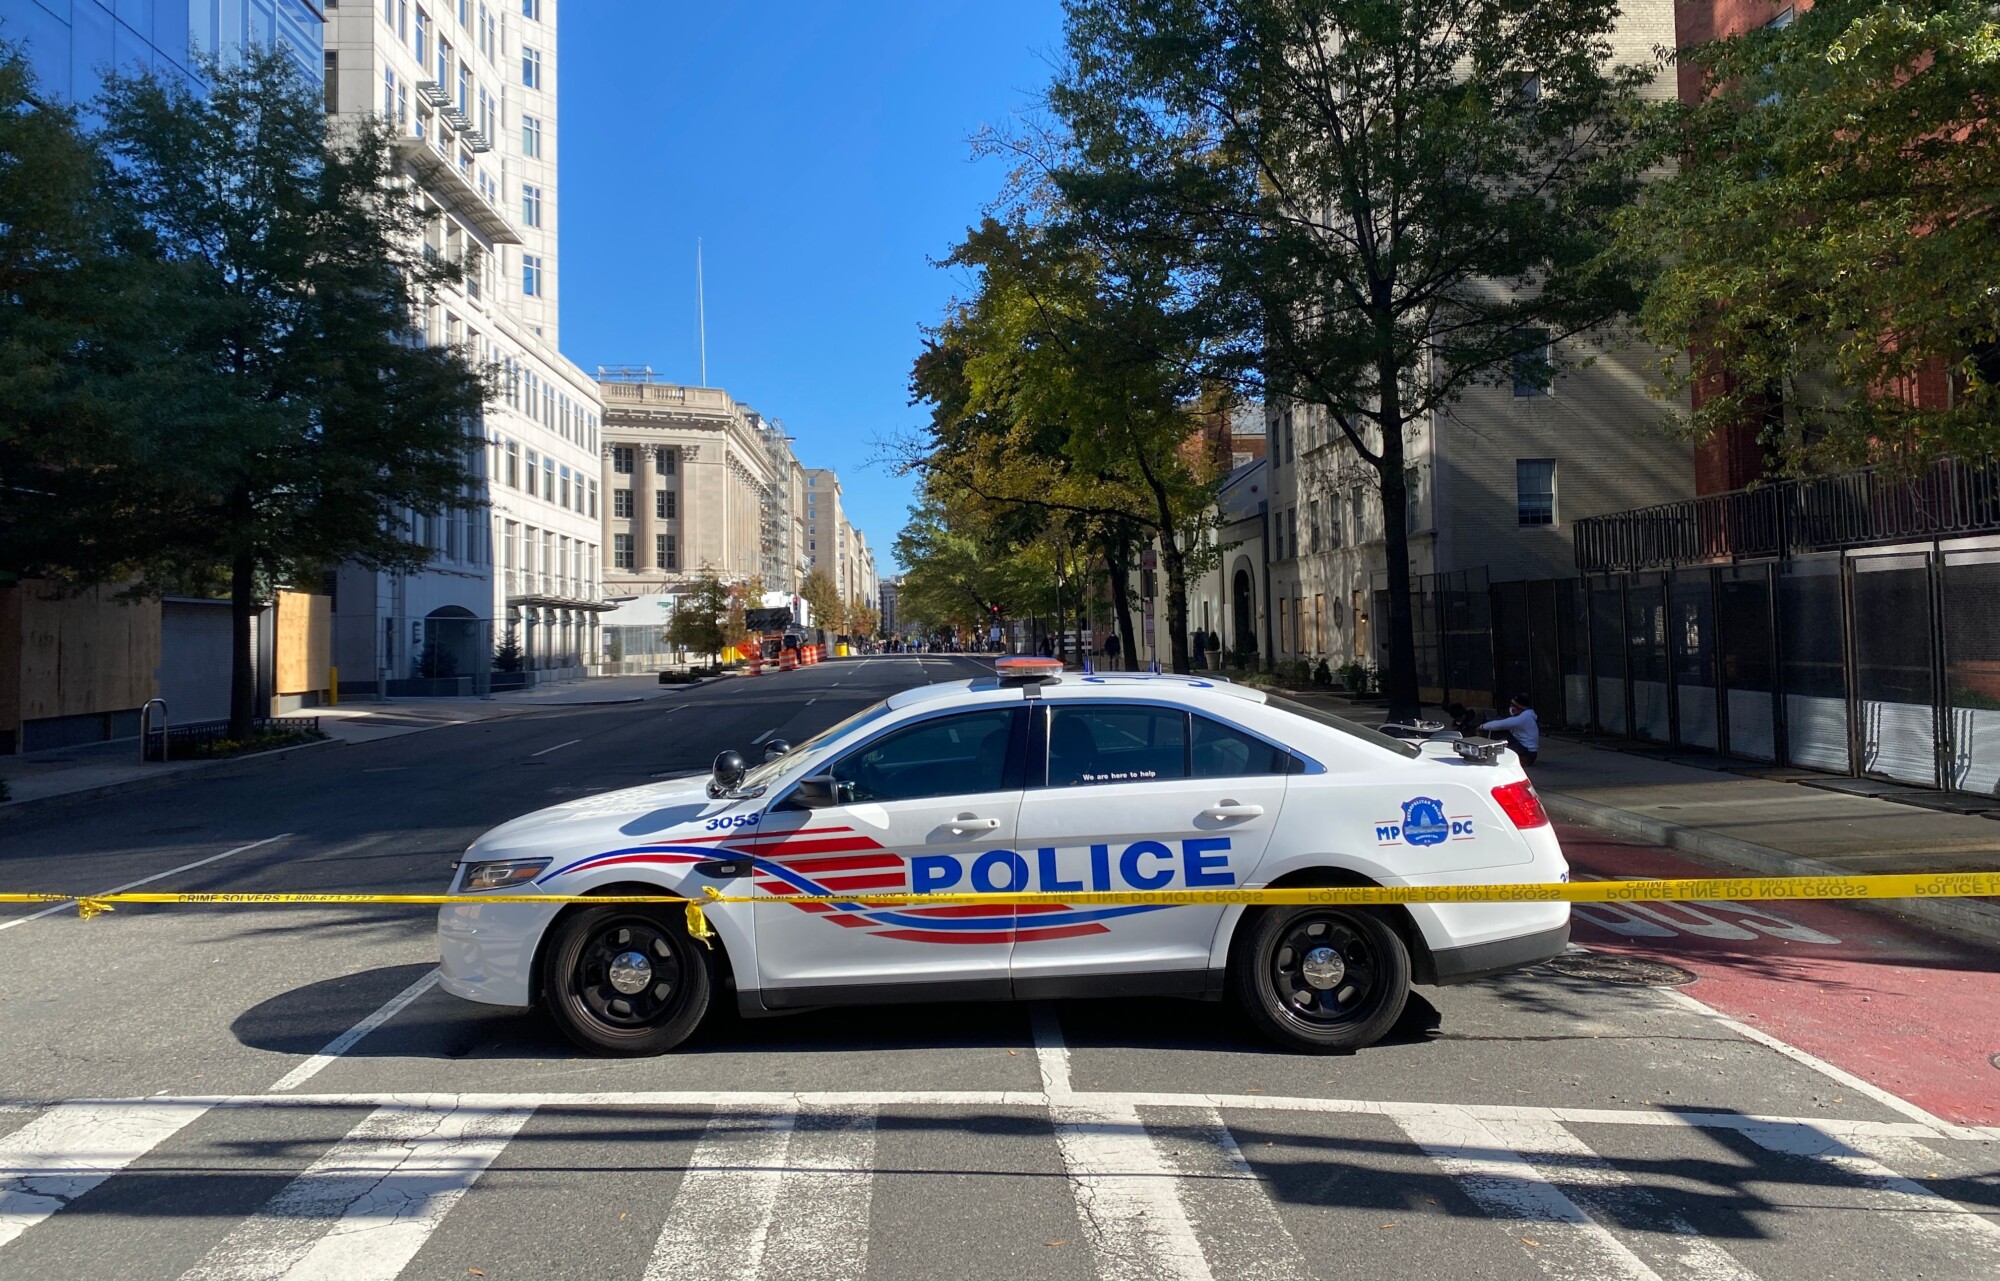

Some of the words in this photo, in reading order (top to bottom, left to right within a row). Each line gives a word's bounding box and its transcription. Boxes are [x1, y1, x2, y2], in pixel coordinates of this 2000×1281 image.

[1140, 770, 1156, 778] help
[705, 813, 760, 831] 3053
[1452, 820, 1474, 835] DC
[1376, 826, 1400, 841] MP
[911, 837, 1236, 904] POLICE
